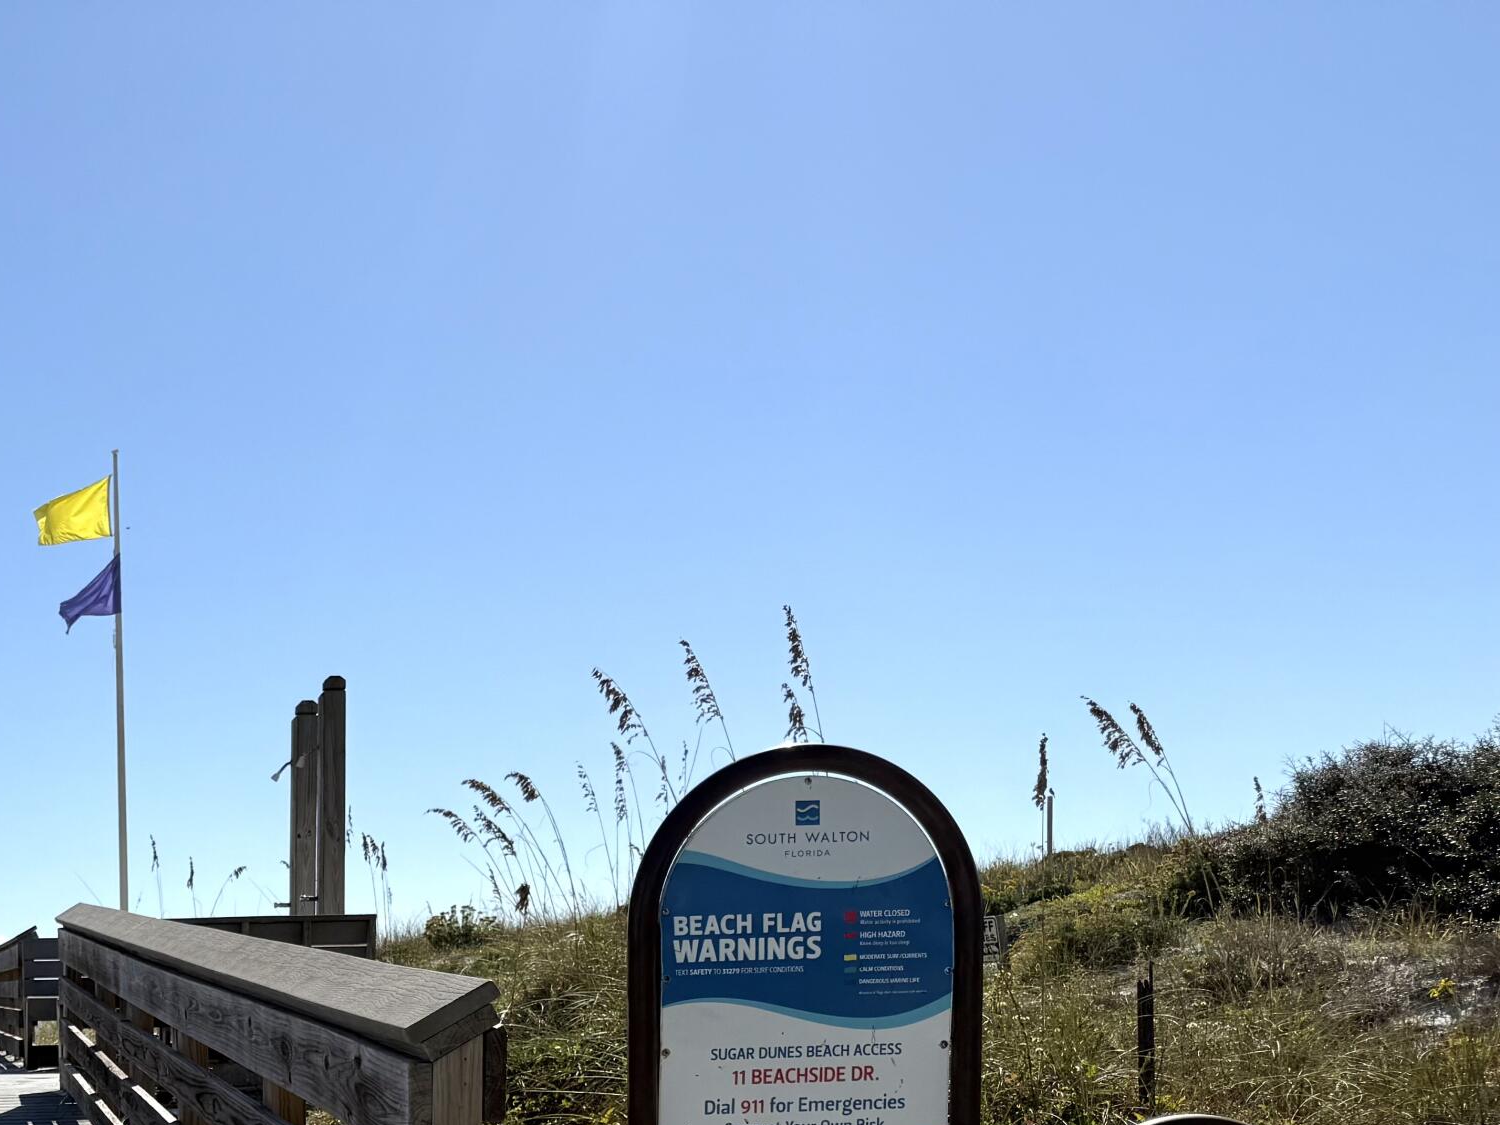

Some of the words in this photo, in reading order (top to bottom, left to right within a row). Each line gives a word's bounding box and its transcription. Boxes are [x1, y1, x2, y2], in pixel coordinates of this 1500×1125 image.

[746, 833, 796, 844] SOUTH
[805, 831, 870, 843] WALTON
[785, 850, 831, 858] FLORIDA
[673, 914, 752, 936] BEACH
[763, 912, 822, 934] FLAG
[673, 935, 822, 963] WARNINGS
[710, 1047, 754, 1060] SUGAR
[759, 1046, 803, 1059] DUNES
[806, 1044, 850, 1058] BEACH
[853, 1043, 902, 1056] ACCESS
[732, 1070, 746, 1085] 11
[751, 1066, 846, 1085] BEACHSIDE
[851, 1065, 879, 1081] DR.
[704, 1098, 735, 1116] Dial
[740, 1100, 764, 1114] 911
[770, 1097, 794, 1113] for
[799, 1094, 906, 1116] Emergencies
